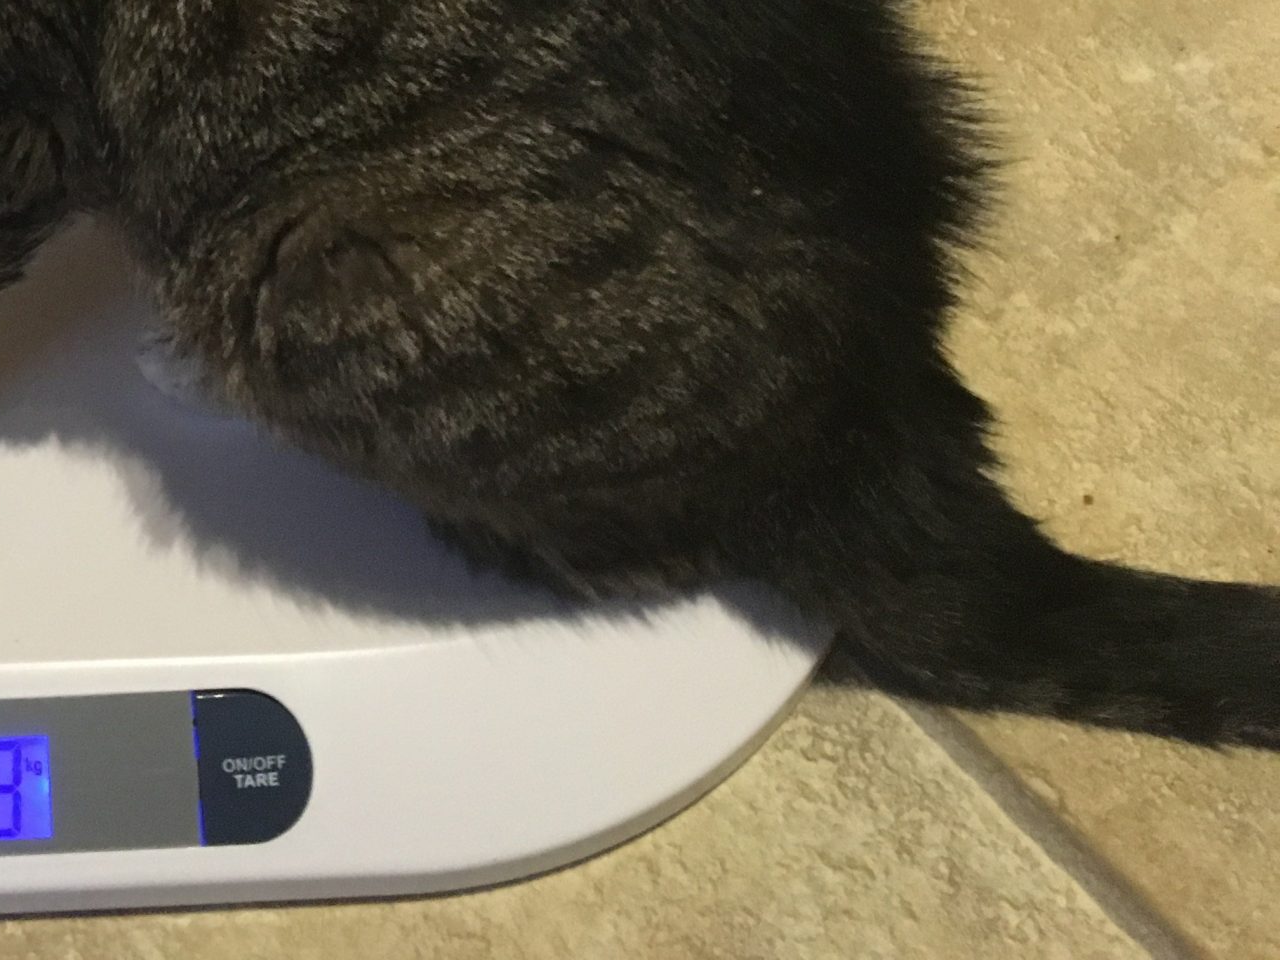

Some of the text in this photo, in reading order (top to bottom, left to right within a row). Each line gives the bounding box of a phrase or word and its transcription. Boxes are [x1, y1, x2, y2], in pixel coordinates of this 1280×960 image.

[25, 757, 42, 776] kg
[222, 755, 286, 773] ON/OFF
[233, 772, 280, 789] TARE
